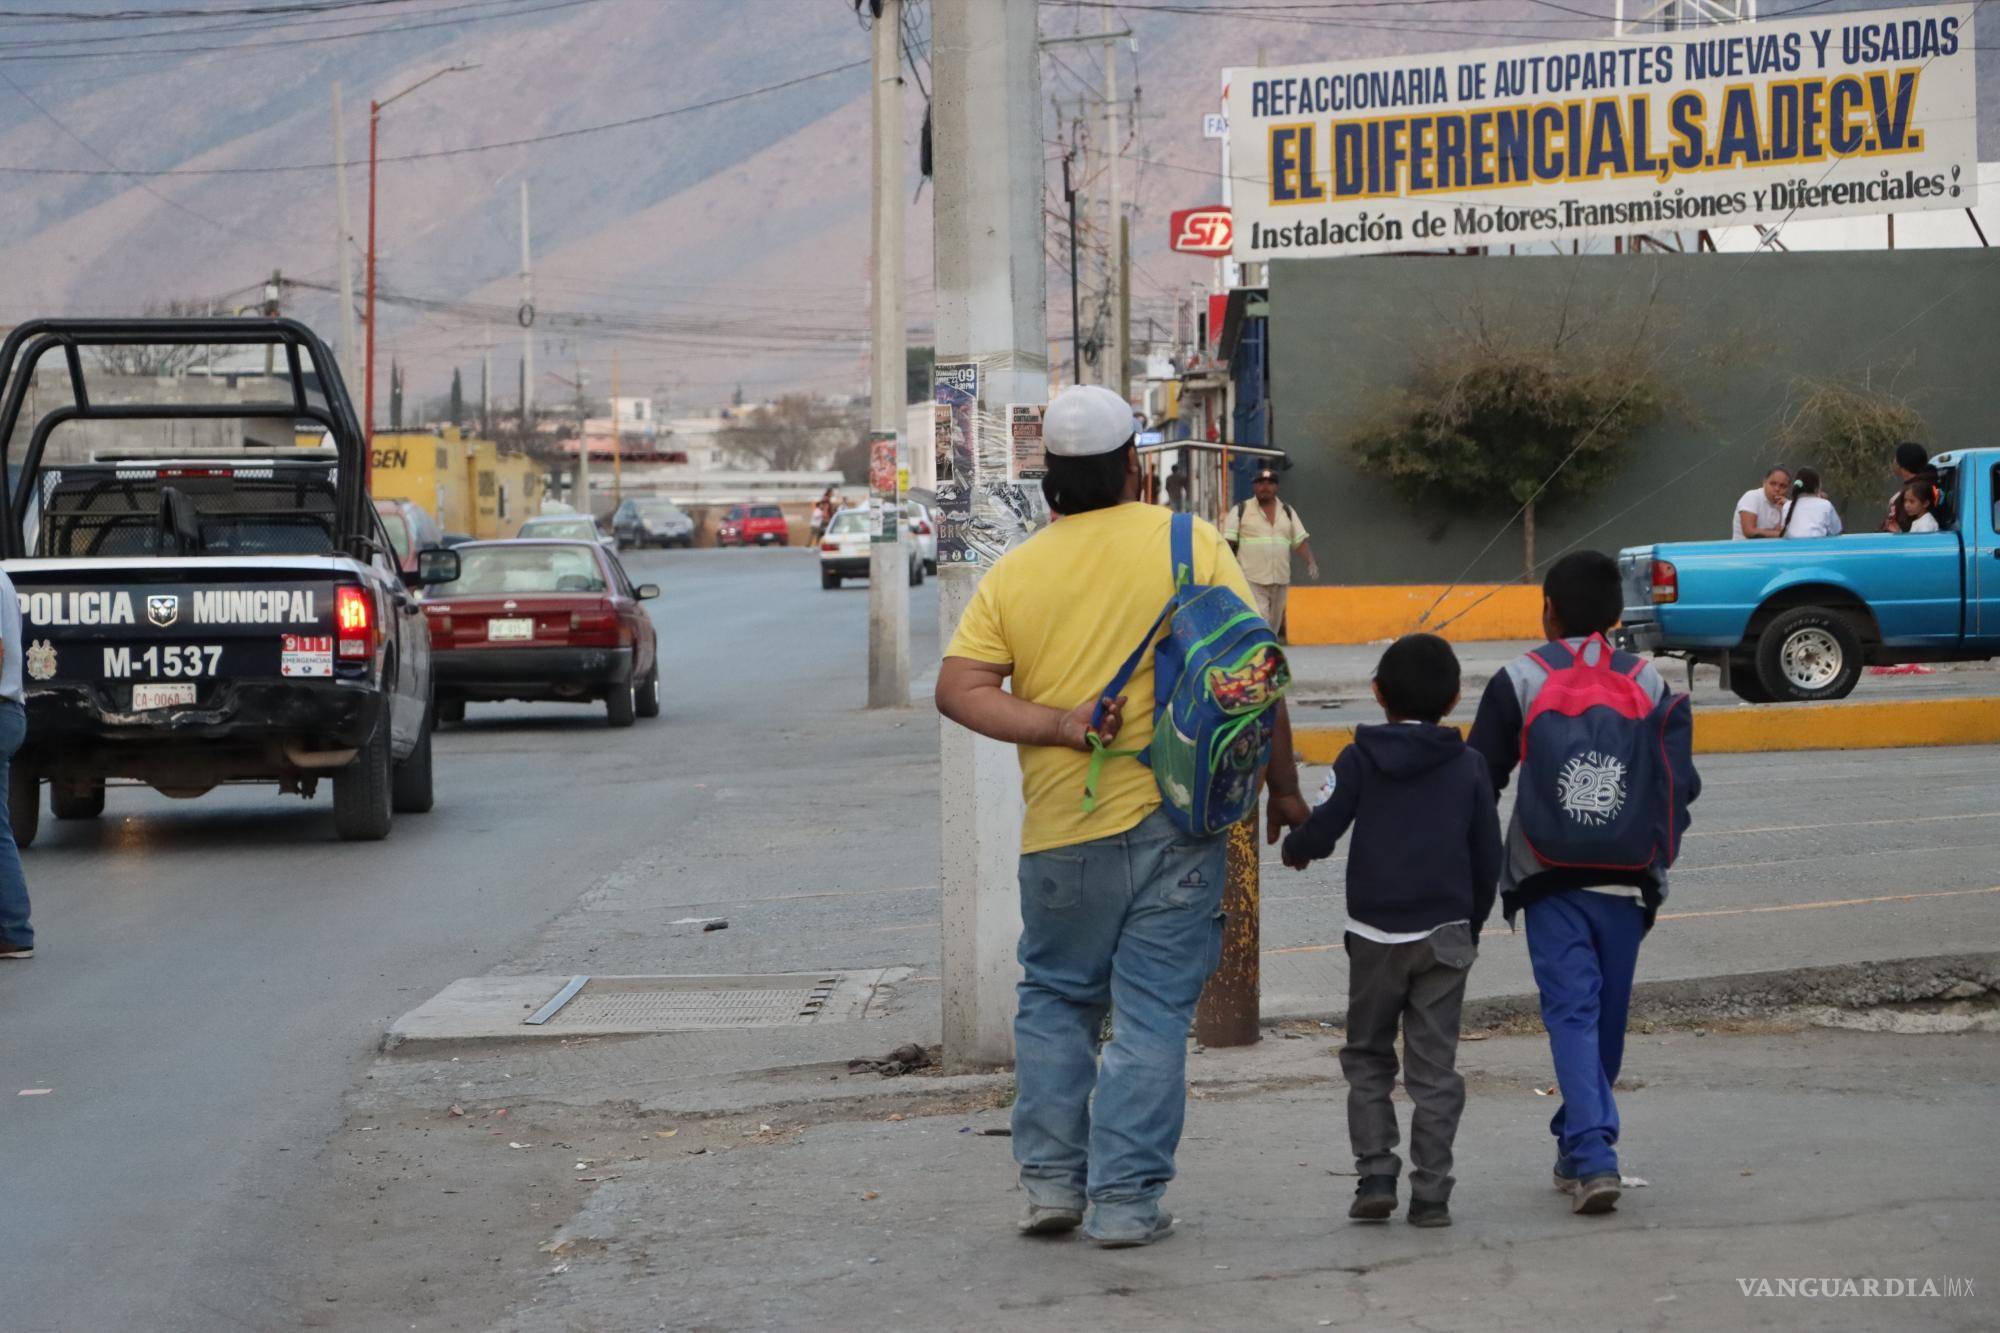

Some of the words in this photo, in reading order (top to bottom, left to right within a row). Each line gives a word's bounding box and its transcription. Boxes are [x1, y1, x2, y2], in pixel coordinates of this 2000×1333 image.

[1251, 66, 1449, 118] REFACCIONARIA
[1457, 62, 1487, 102] DE
[1493, 44, 1674, 99] AUTOPARTES
[1684, 31, 1801, 81] NUEVAS
[1809, 28, 1832, 69] Y
[1842, 15, 1959, 66] USADAS
[1269, 124, 1325, 204] EL
[1250, 211, 1404, 250] Instalación
[1411, 210, 1447, 239] de
[1752, 188, 1767, 213] Y
[958, 369, 975, 382] 09
[19, 591, 136, 626] POLICIA
[193, 590, 319, 624] MUNICIPAL
[103, 645, 223, 678] M-1537
[1568, 765, 1622, 811] 25
